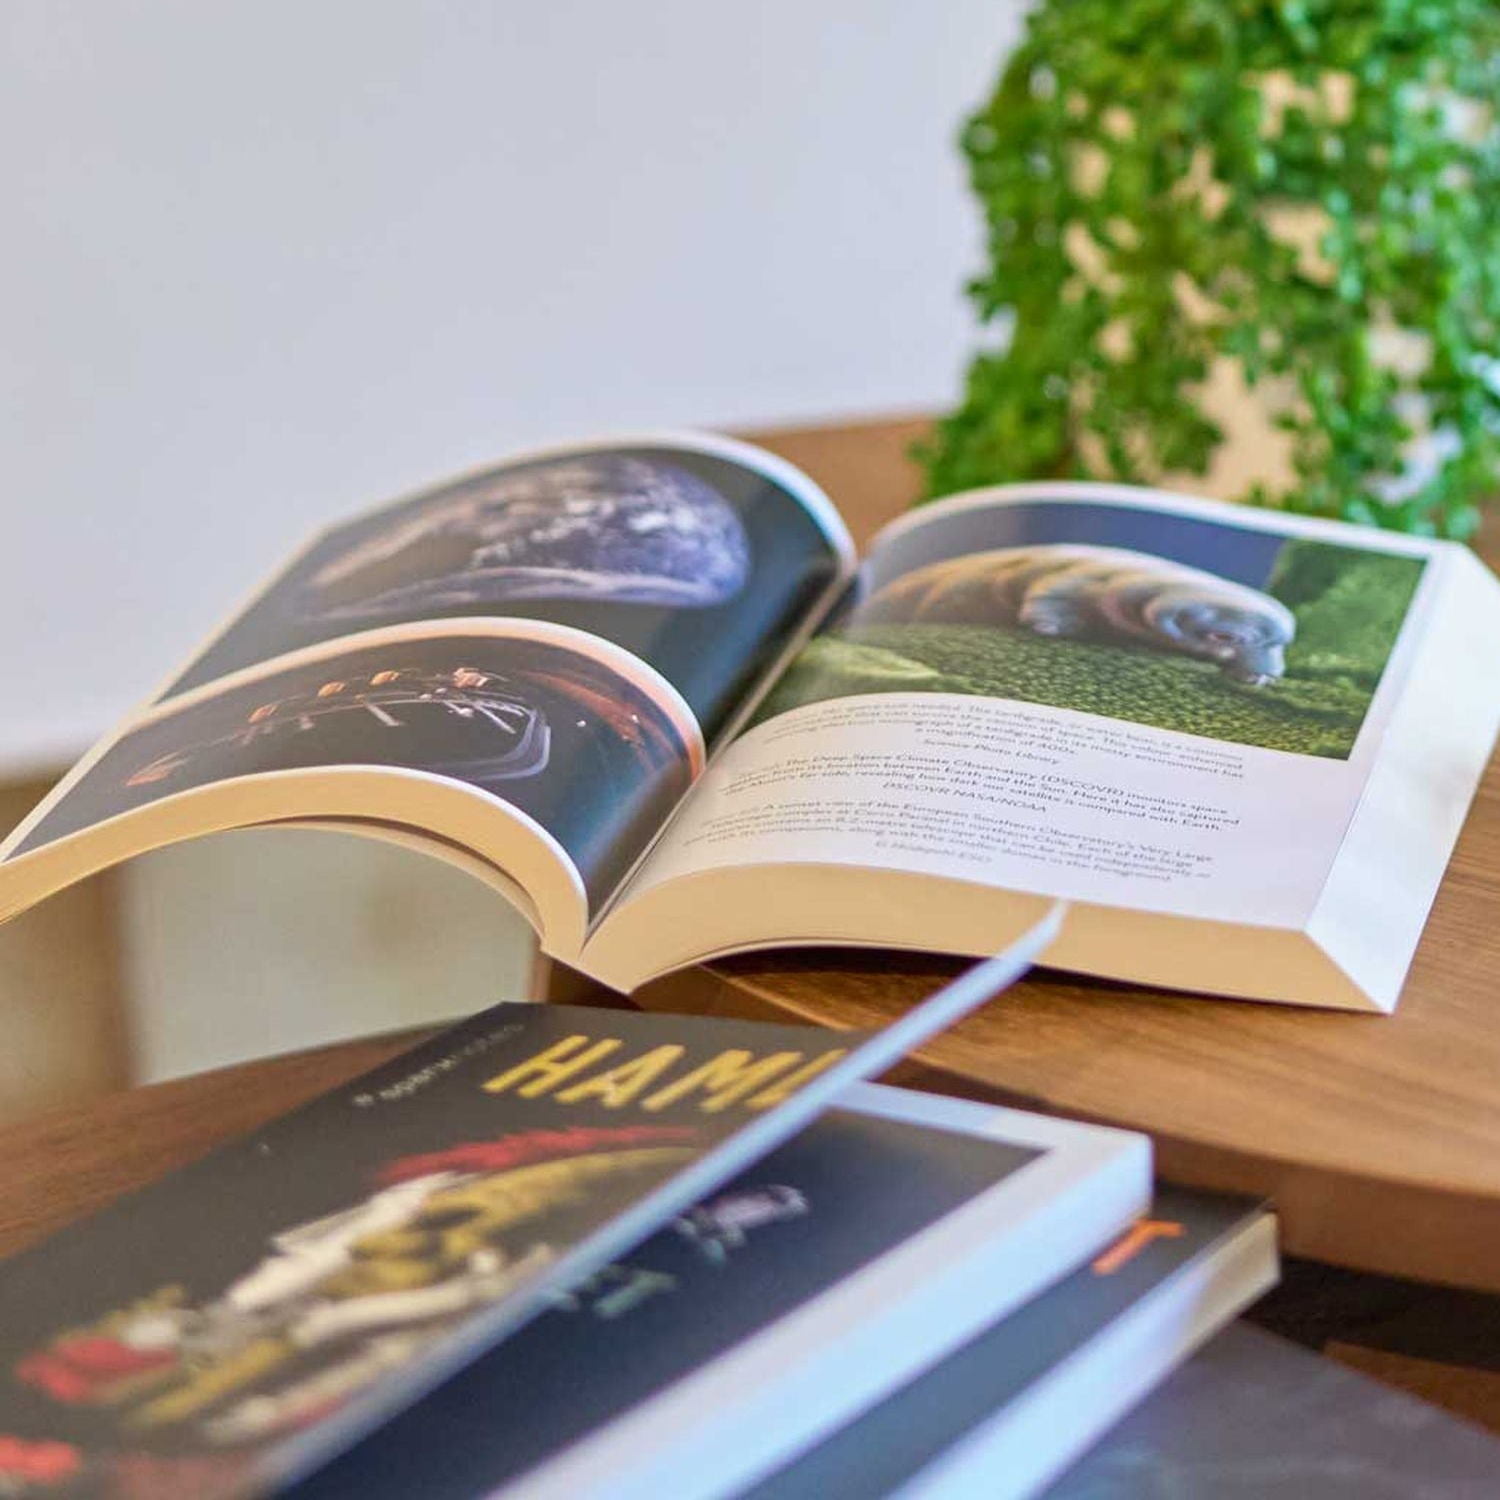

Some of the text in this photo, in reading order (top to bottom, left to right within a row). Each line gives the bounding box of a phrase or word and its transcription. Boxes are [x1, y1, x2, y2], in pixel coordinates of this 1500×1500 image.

[895, 753, 951, 766] Climate
[952, 758, 1037, 780] Observatory
[1039, 772, 1125, 797] (DSCOVR)
[943, 765, 983, 778] Earth
[984, 771, 1011, 783] and
[1012, 776, 1037, 788] the
[1071, 787, 1108, 802] Here
[902, 803, 970, 821] European
[948, 776, 978, 788] dark
[1008, 786, 1062, 804] satellite
[1077, 800, 1147, 821] compared
[1148, 813, 1179, 826] with
[952, 788, 1047, 812] NASA/NOAA
